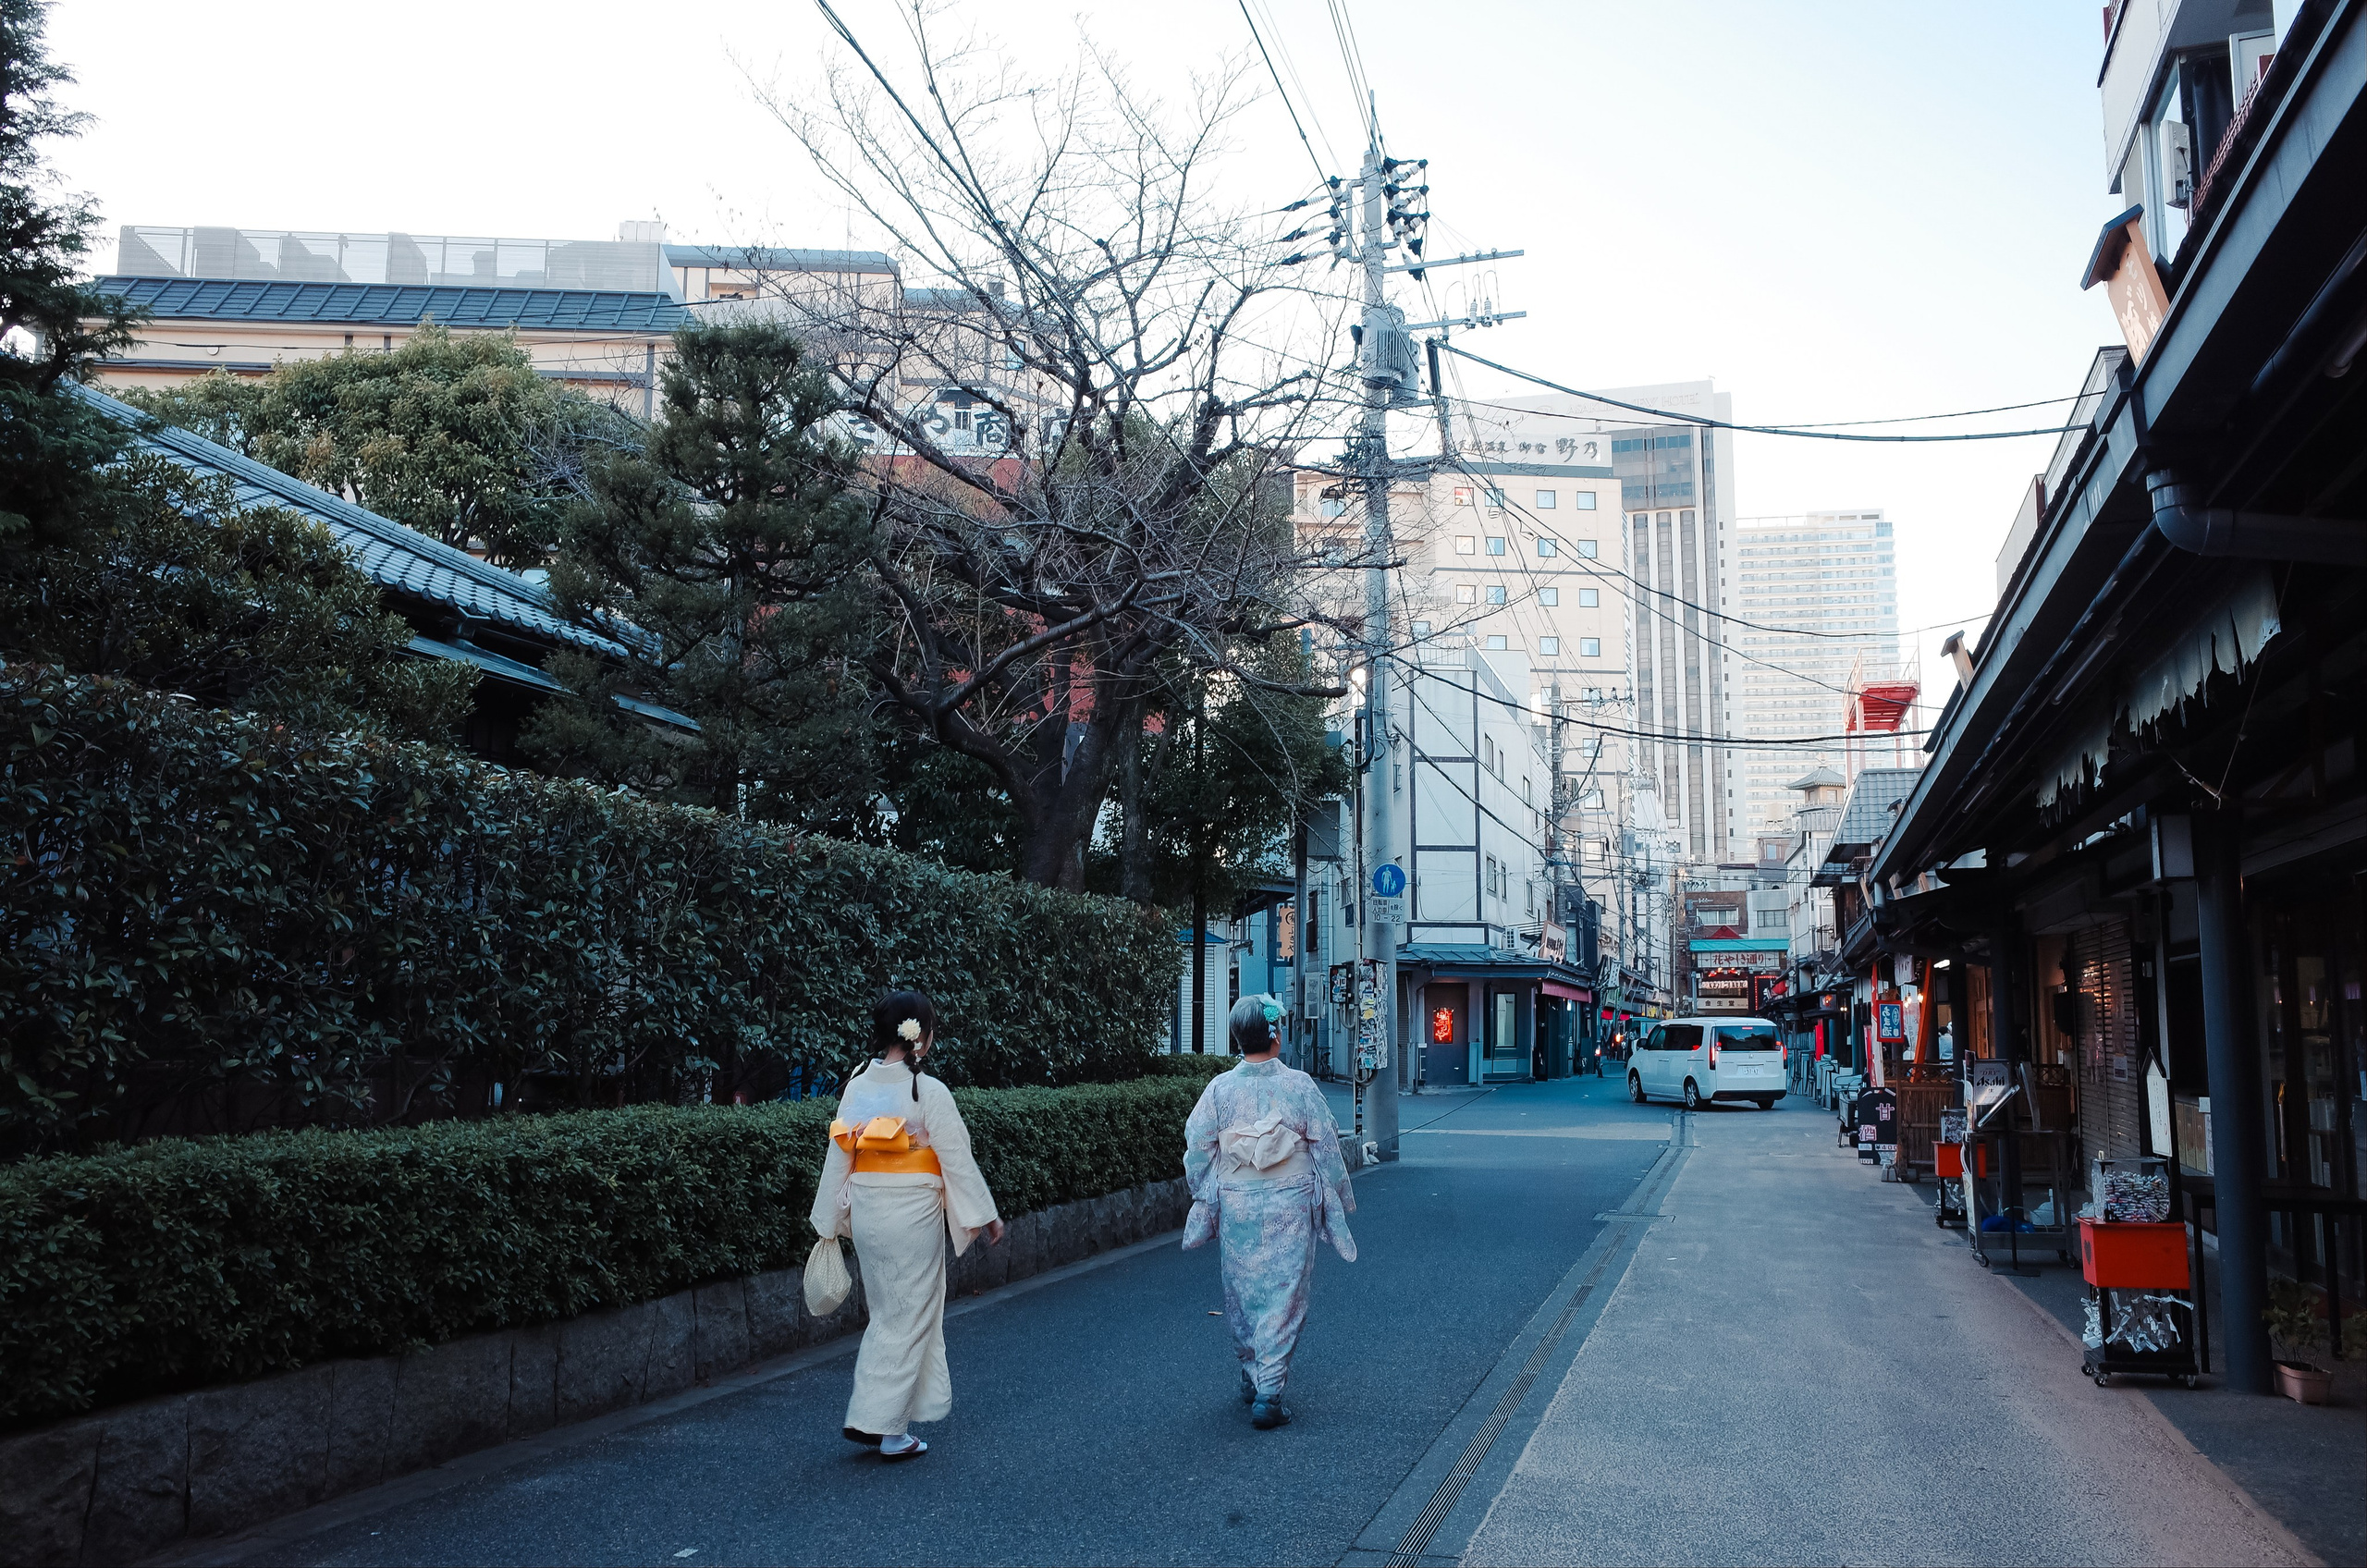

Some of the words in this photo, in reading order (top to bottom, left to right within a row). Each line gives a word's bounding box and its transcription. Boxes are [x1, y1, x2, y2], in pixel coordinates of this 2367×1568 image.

[1661, 393, 1701, 408] HOTEL
[1711, 953, 1764, 965] 花やしき通り
[1976, 1075, 2005, 1087] Asahi
